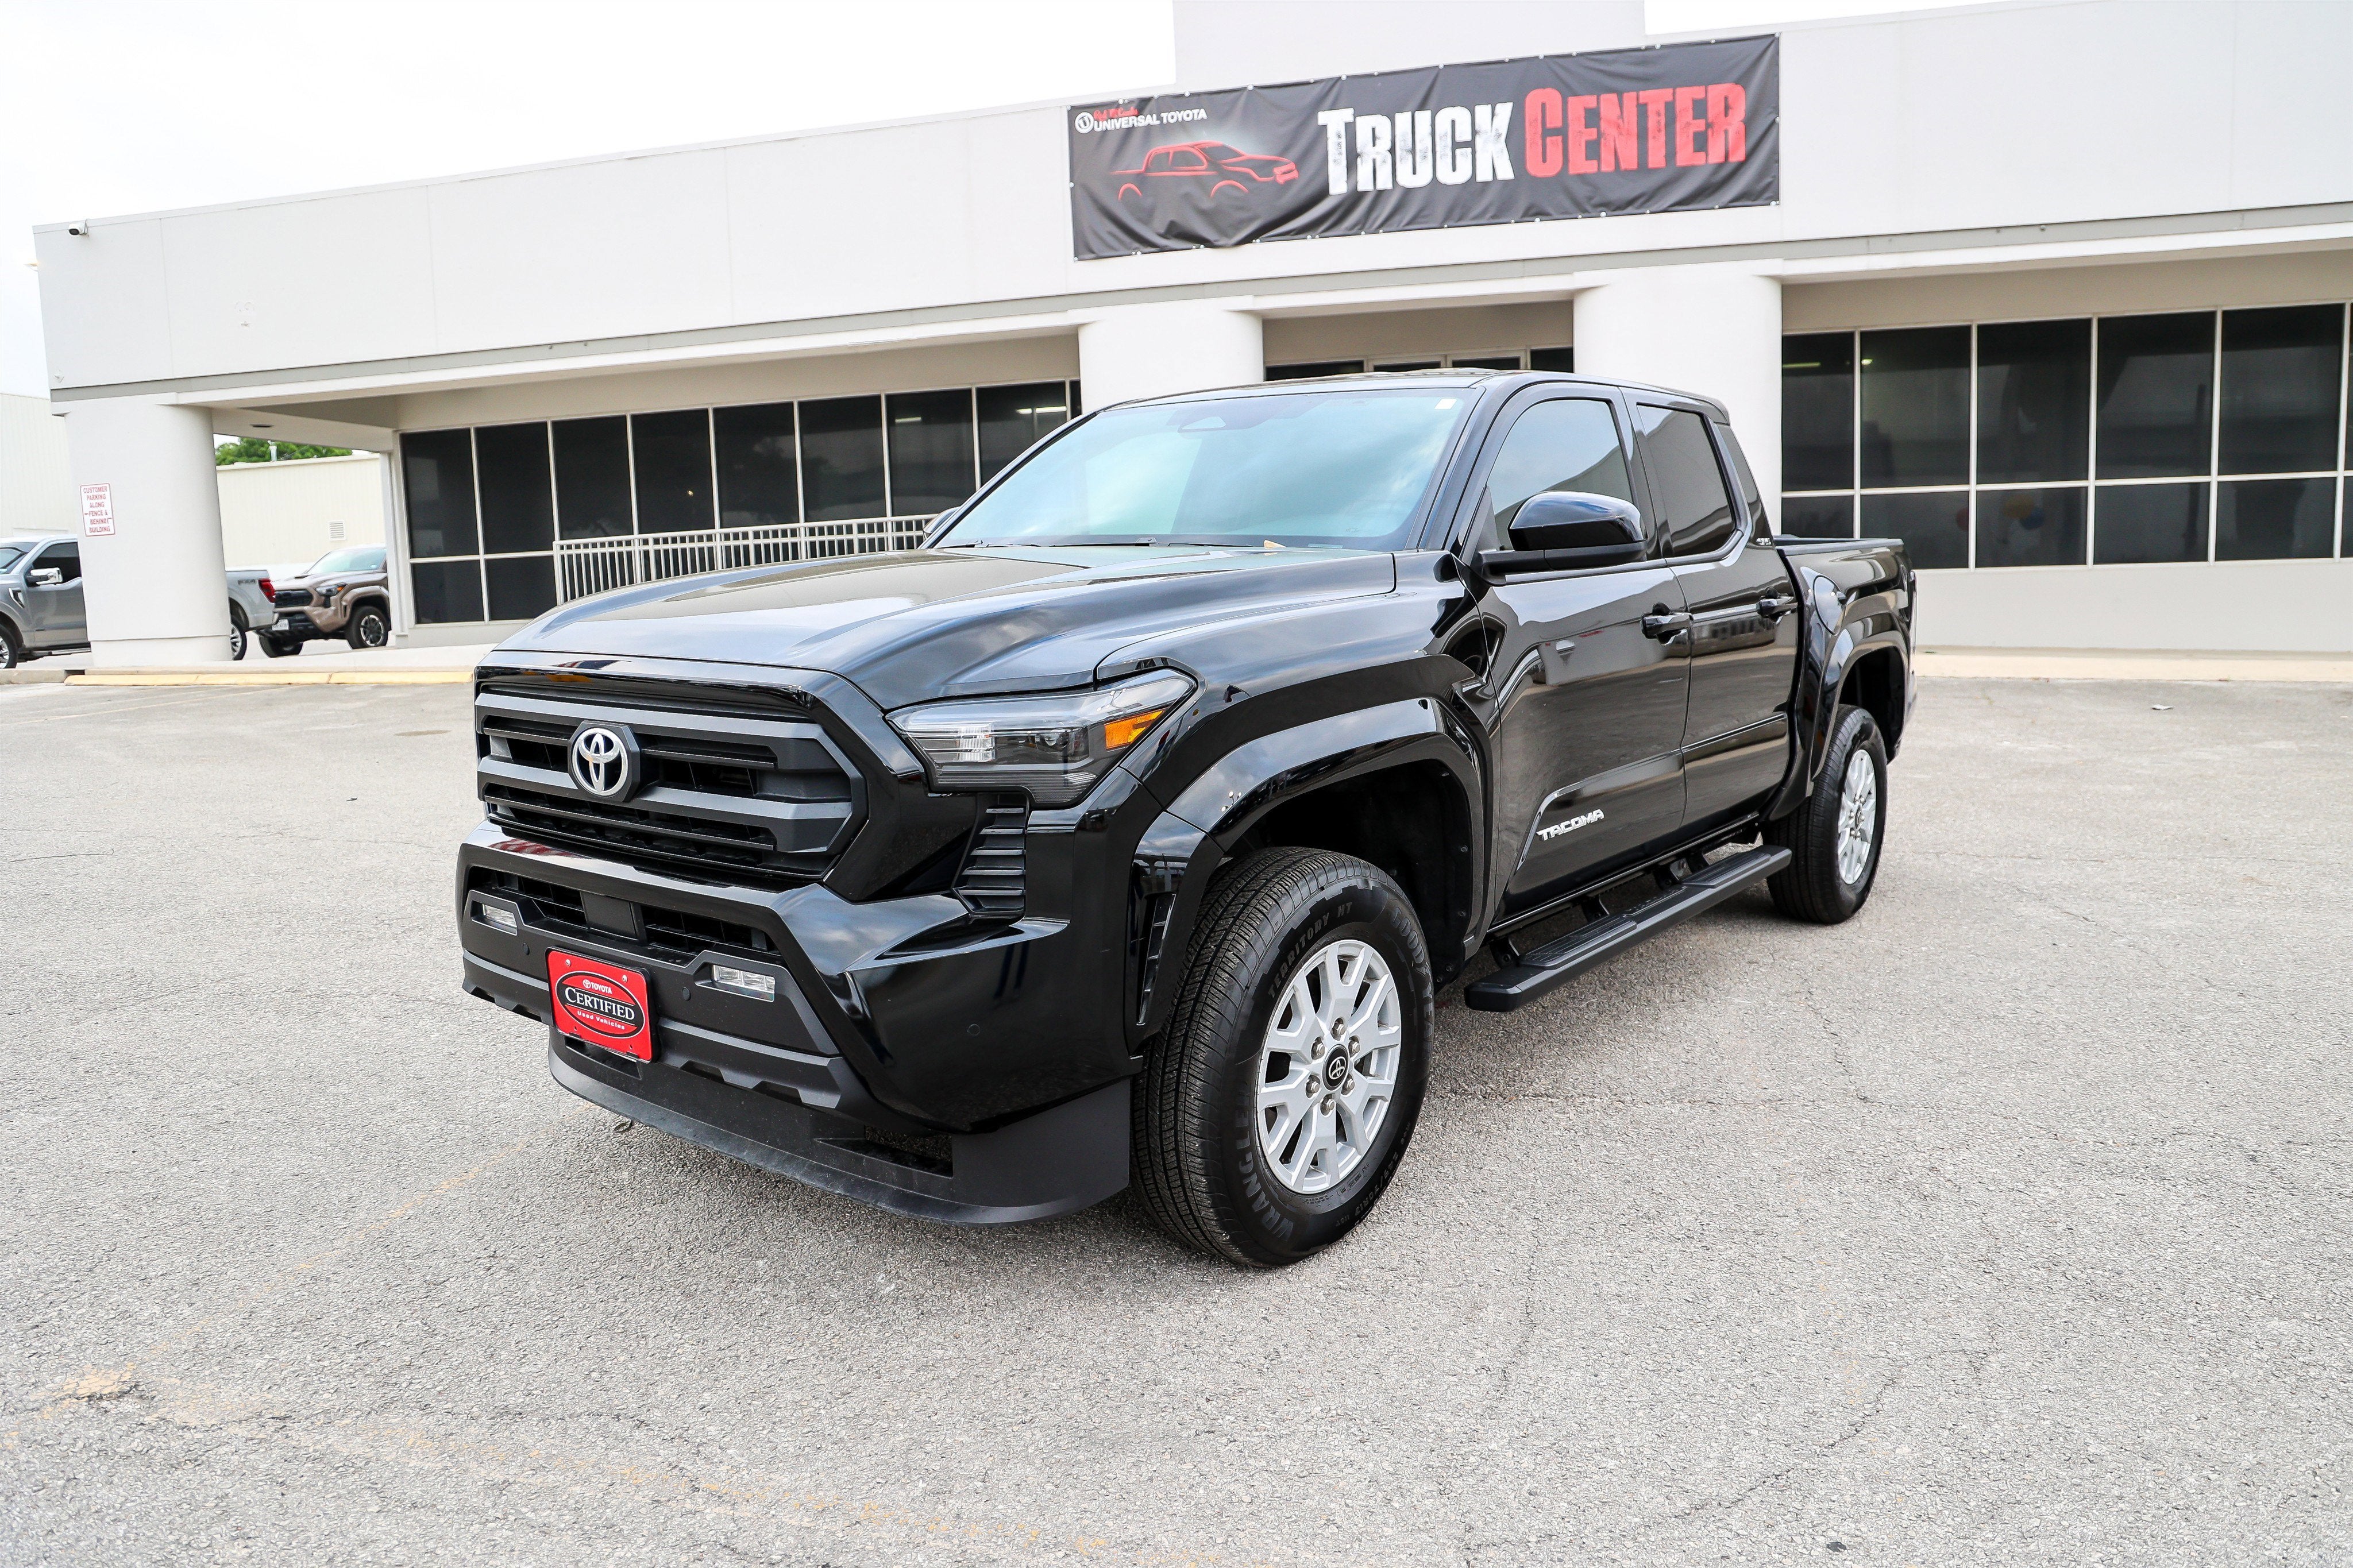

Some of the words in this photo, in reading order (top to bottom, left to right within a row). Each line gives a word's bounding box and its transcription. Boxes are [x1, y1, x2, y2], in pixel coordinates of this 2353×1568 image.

[1094, 113, 1160, 132] UNIVERSAL
[1160, 108, 1208, 123] TOYOTA
[1317, 102, 1515, 196] TRUCK
[1524, 83, 1747, 179] CENTER
[1536, 809, 1605, 841] TACOMA
[1268, 913, 1329, 998] TERRITORY
[1337, 902, 1353, 918] HT
[565, 987, 635, 1020] CERTIFIED
[591, 982, 612, 995] TOYOTA
[577, 1010, 594, 1020] Used
[596, 1016, 625, 1030] Vehicles
